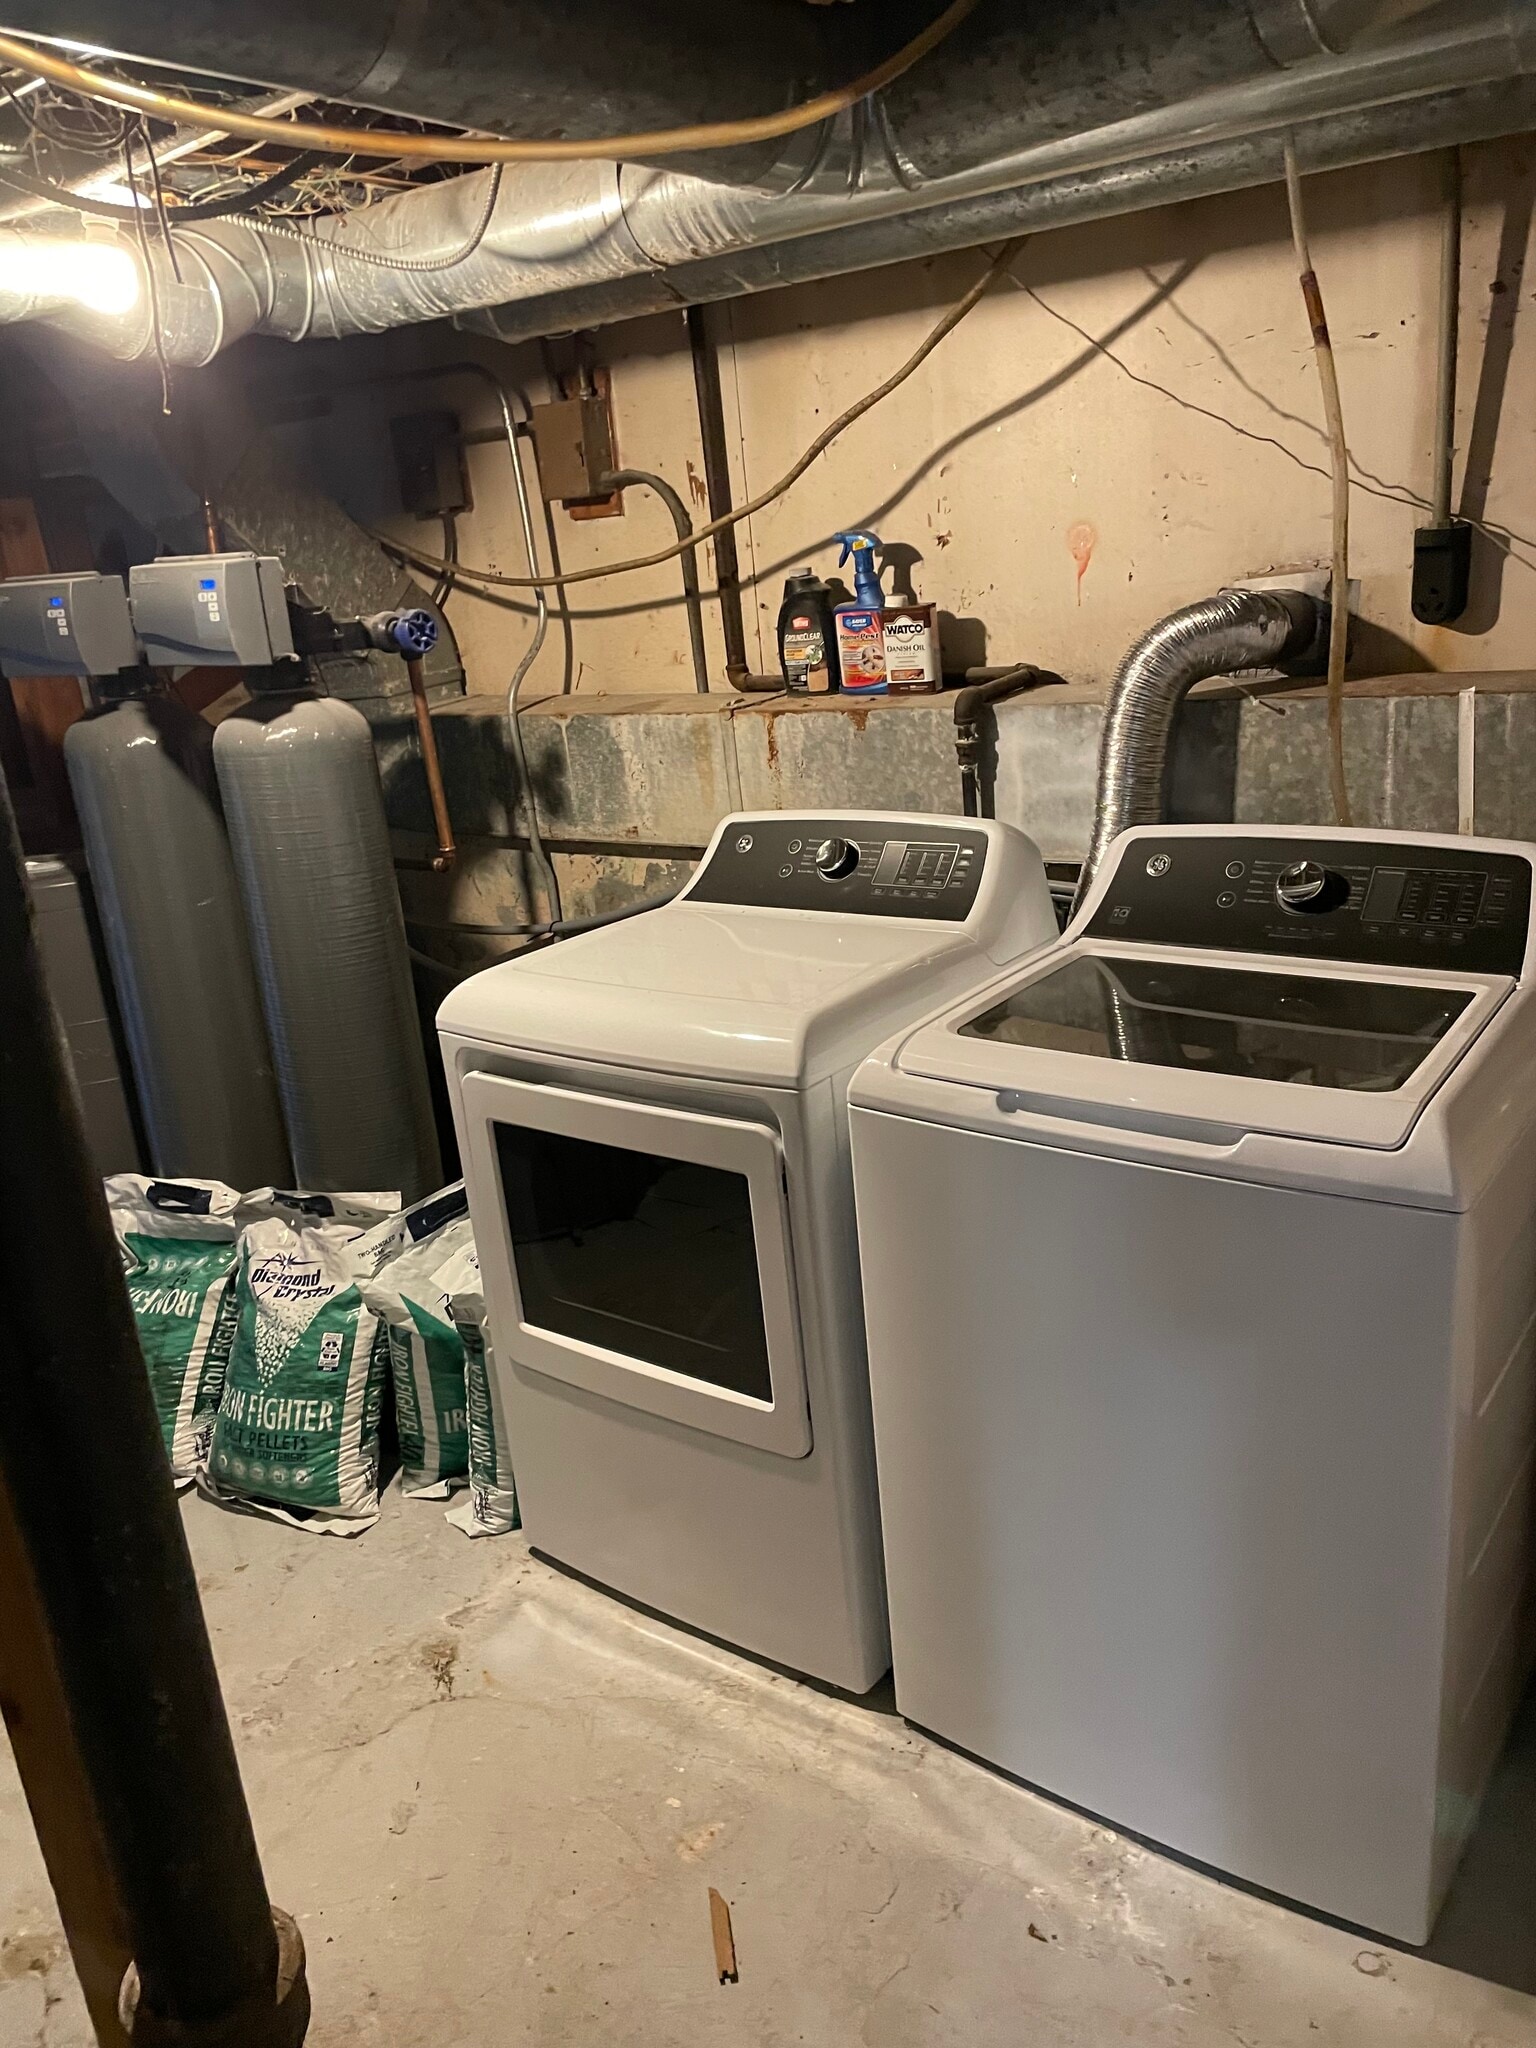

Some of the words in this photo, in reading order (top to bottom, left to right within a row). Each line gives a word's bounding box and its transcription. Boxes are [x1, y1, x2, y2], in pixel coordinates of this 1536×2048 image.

[886, 624, 923, 635] WATCO
[886, 645, 912, 653] DANISH
[251, 1268, 322, 1287] Diamond
[273, 1284, 336, 1302] Crystal
[391, 1340, 410, 1382] IRON
[246, 1394, 334, 1432] FIGHTER
[443, 1408, 467, 1434] IR
[249, 1431, 309, 1451] PELLETS
[471, 1422, 493, 1467] IRON
